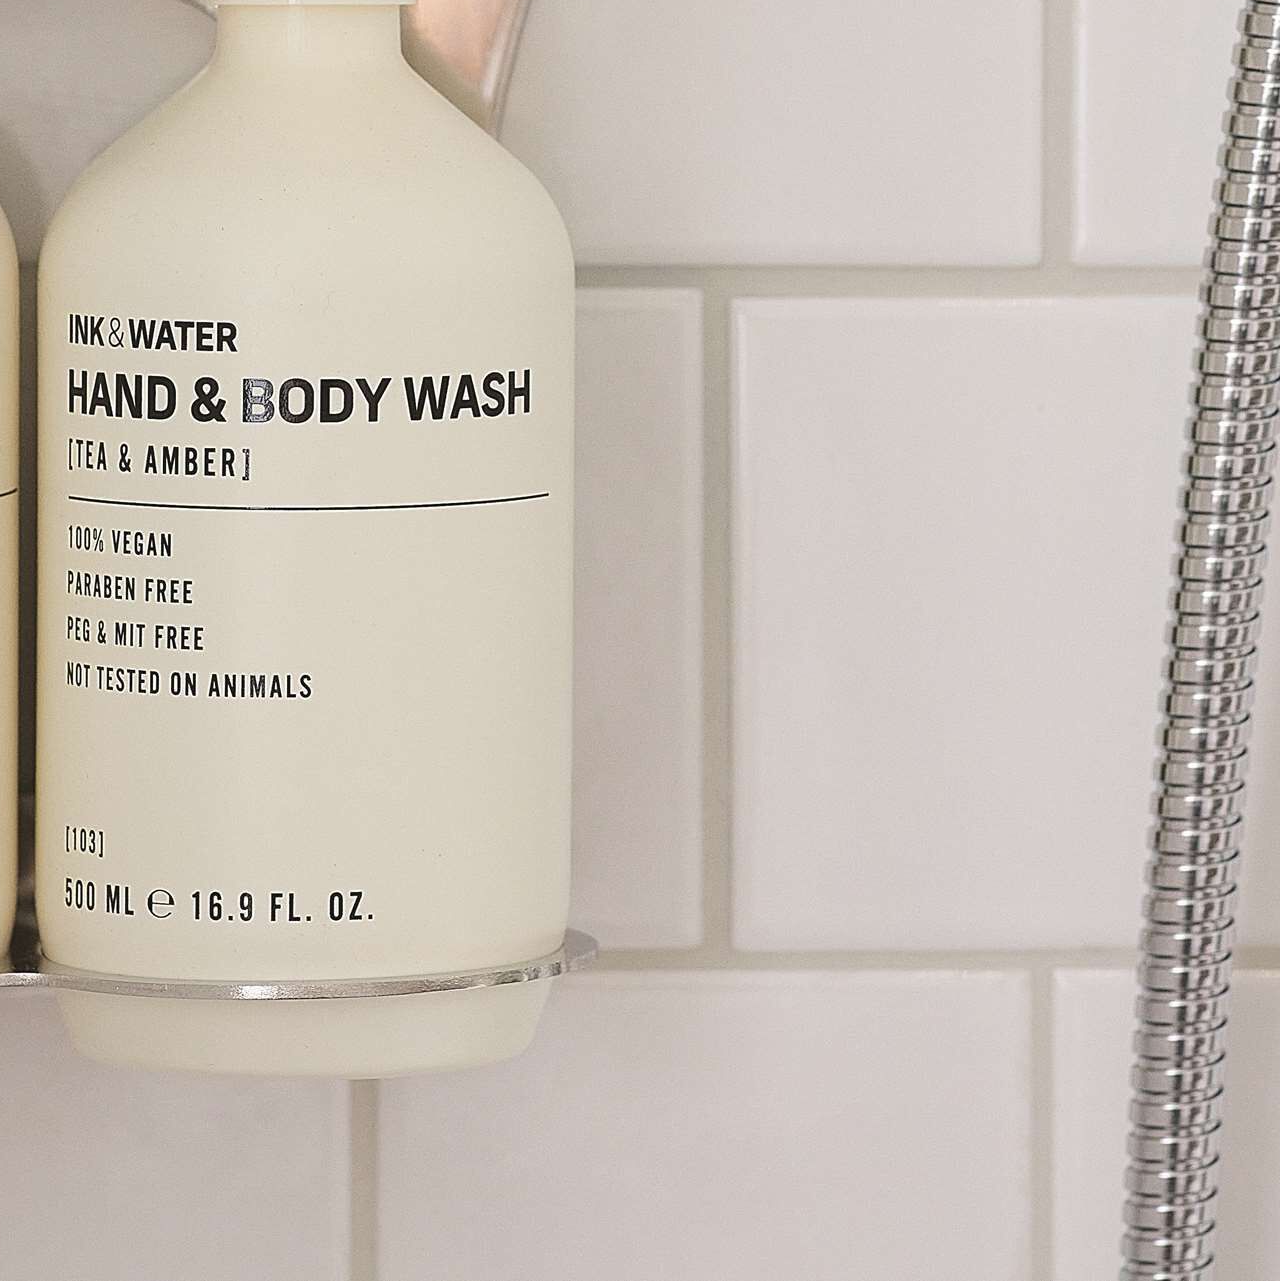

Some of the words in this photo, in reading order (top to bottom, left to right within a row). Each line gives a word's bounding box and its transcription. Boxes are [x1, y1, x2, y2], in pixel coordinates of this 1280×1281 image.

[68, 368, 177, 420] HAND
[190, 376, 227, 423] &
[242, 377, 392, 424] BODY
[403, 368, 531, 421] WASH
[68, 437, 108, 471] [TEA
[118, 443, 132, 473] &
[144, 445, 250, 481] AMBER]
[68, 524, 104, 553] 100%
[111, 529, 172, 557] VEGAN
[67, 570, 136, 601] PARABEN
[145, 578, 193, 604] FREE
[67, 615, 90, 642] PEG
[97, 620, 107, 644] &
[114, 621, 146, 648] MIT
[154, 624, 204, 651] FREE
[66, 661, 91, 689] NOT
[96, 665, 160, 695] TESTED
[170, 671, 197, 697] ON
[208, 673, 312, 699] ANIMALS
[65, 825, 104, 858] [103]
[65, 877, 95, 911] 500
[106, 884, 135, 916] ML
[191, 891, 253, 922] 16.9
[270, 892, 312, 922] FL.
[329, 891, 373, 922] OZ.
